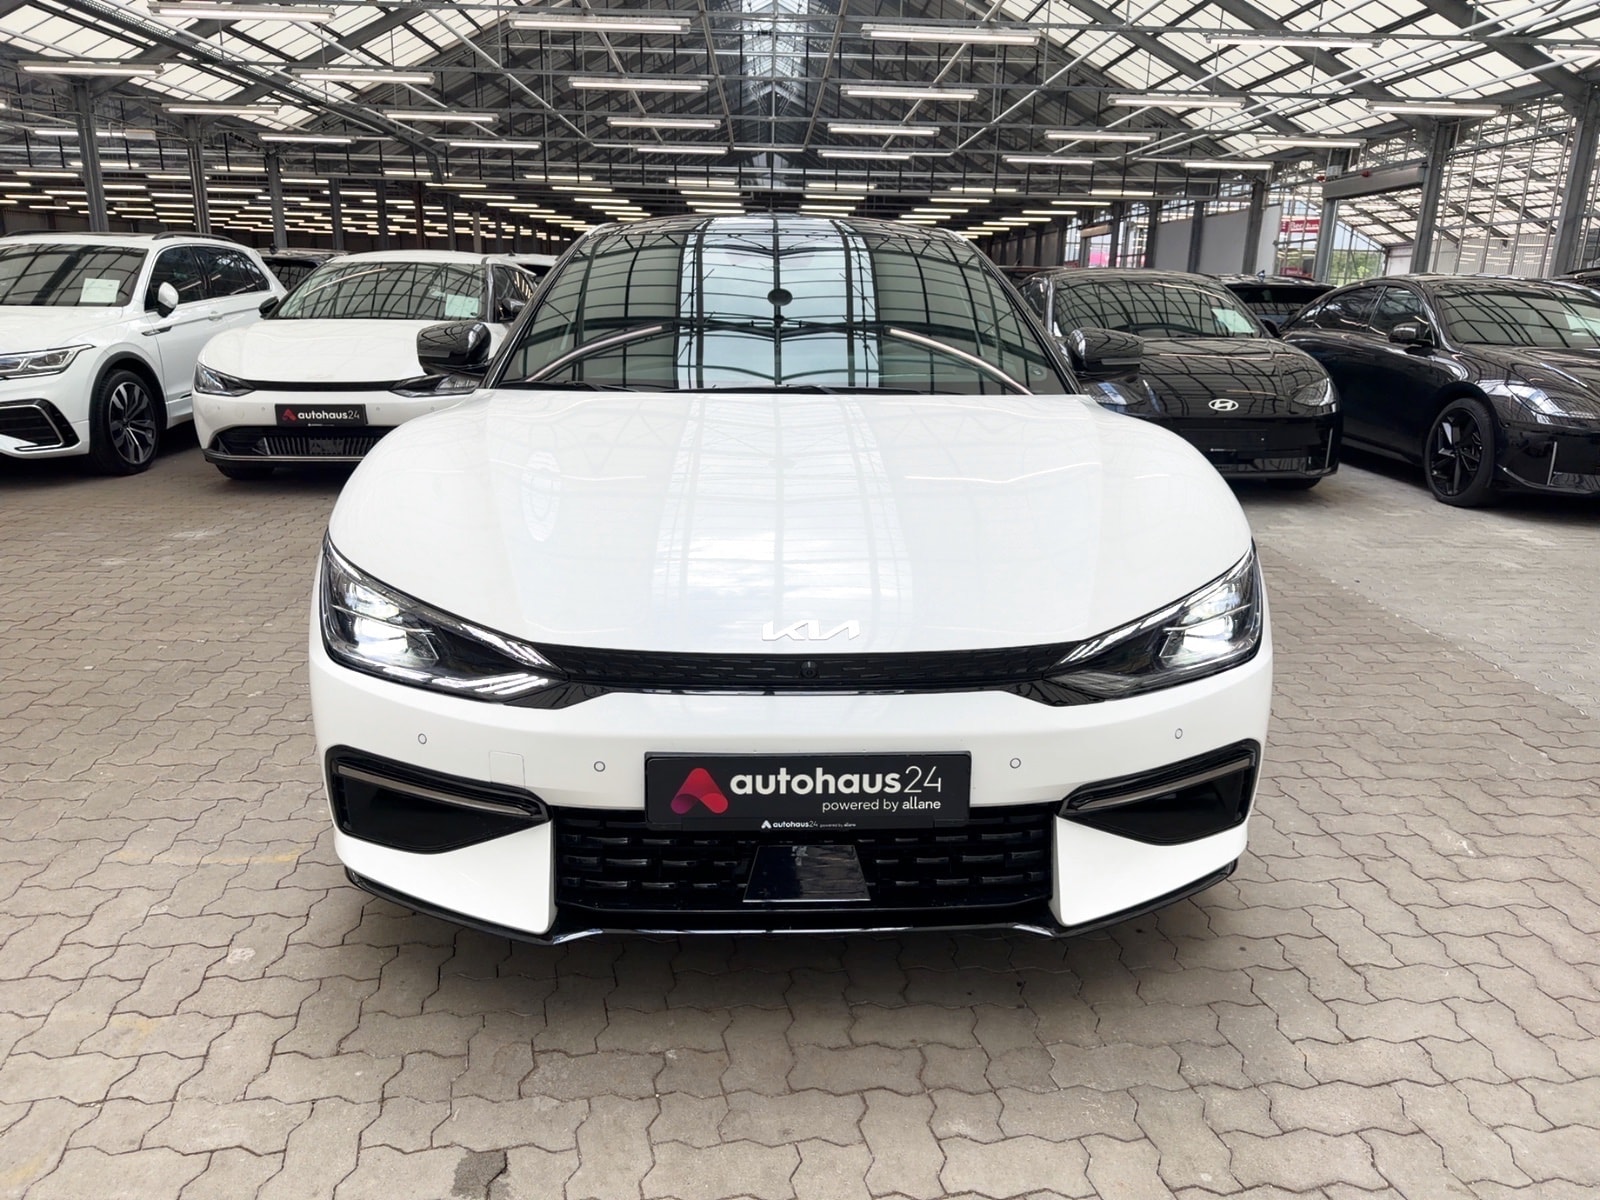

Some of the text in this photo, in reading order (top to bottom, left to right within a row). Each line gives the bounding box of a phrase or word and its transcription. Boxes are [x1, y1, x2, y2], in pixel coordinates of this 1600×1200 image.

[298, 410, 360, 420] autohaus24
[762, 619, 861, 641] KIA
[730, 765, 942, 795] autohaus24
[822, 796, 942, 813] powered by allane
[772, 820, 818, 828] autohaus24
